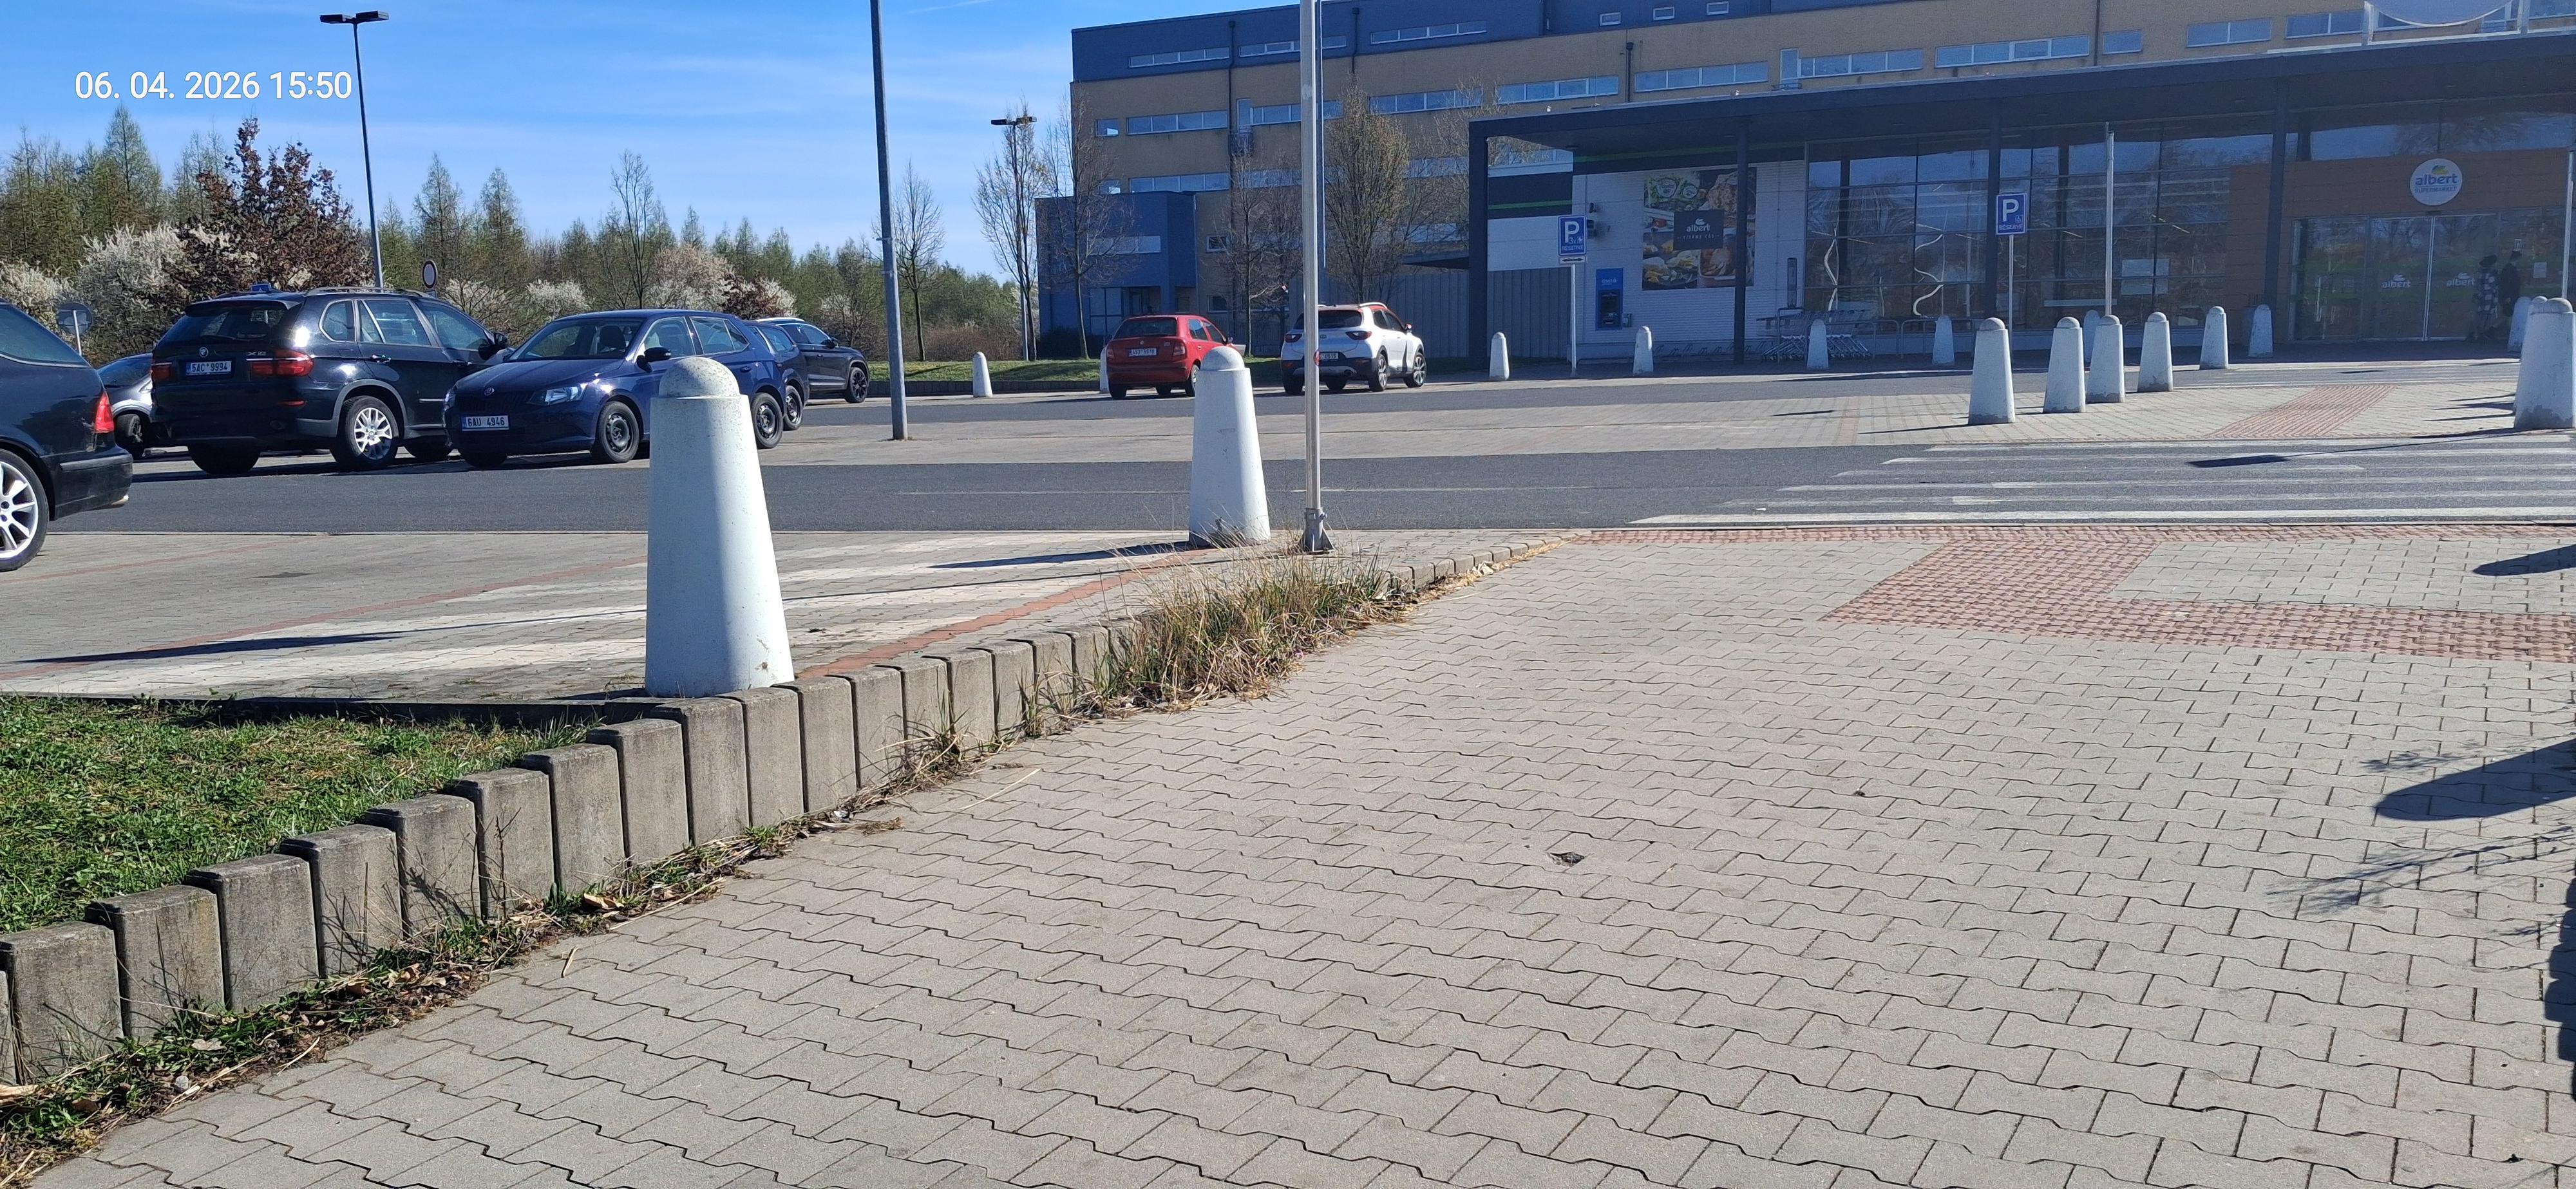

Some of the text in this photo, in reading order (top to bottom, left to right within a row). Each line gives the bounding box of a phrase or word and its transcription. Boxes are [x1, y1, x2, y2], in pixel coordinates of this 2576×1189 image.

[2416, 173, 2458, 185] albert
[2002, 199, 2020, 221] P
[1565, 221, 1580, 243] P
[1686, 223, 1711, 232] albert
[2382, 279, 2412, 288] albert
[191, 362, 228, 373] 5AC 9994
[468, 417, 505, 427] 6AU 4946
